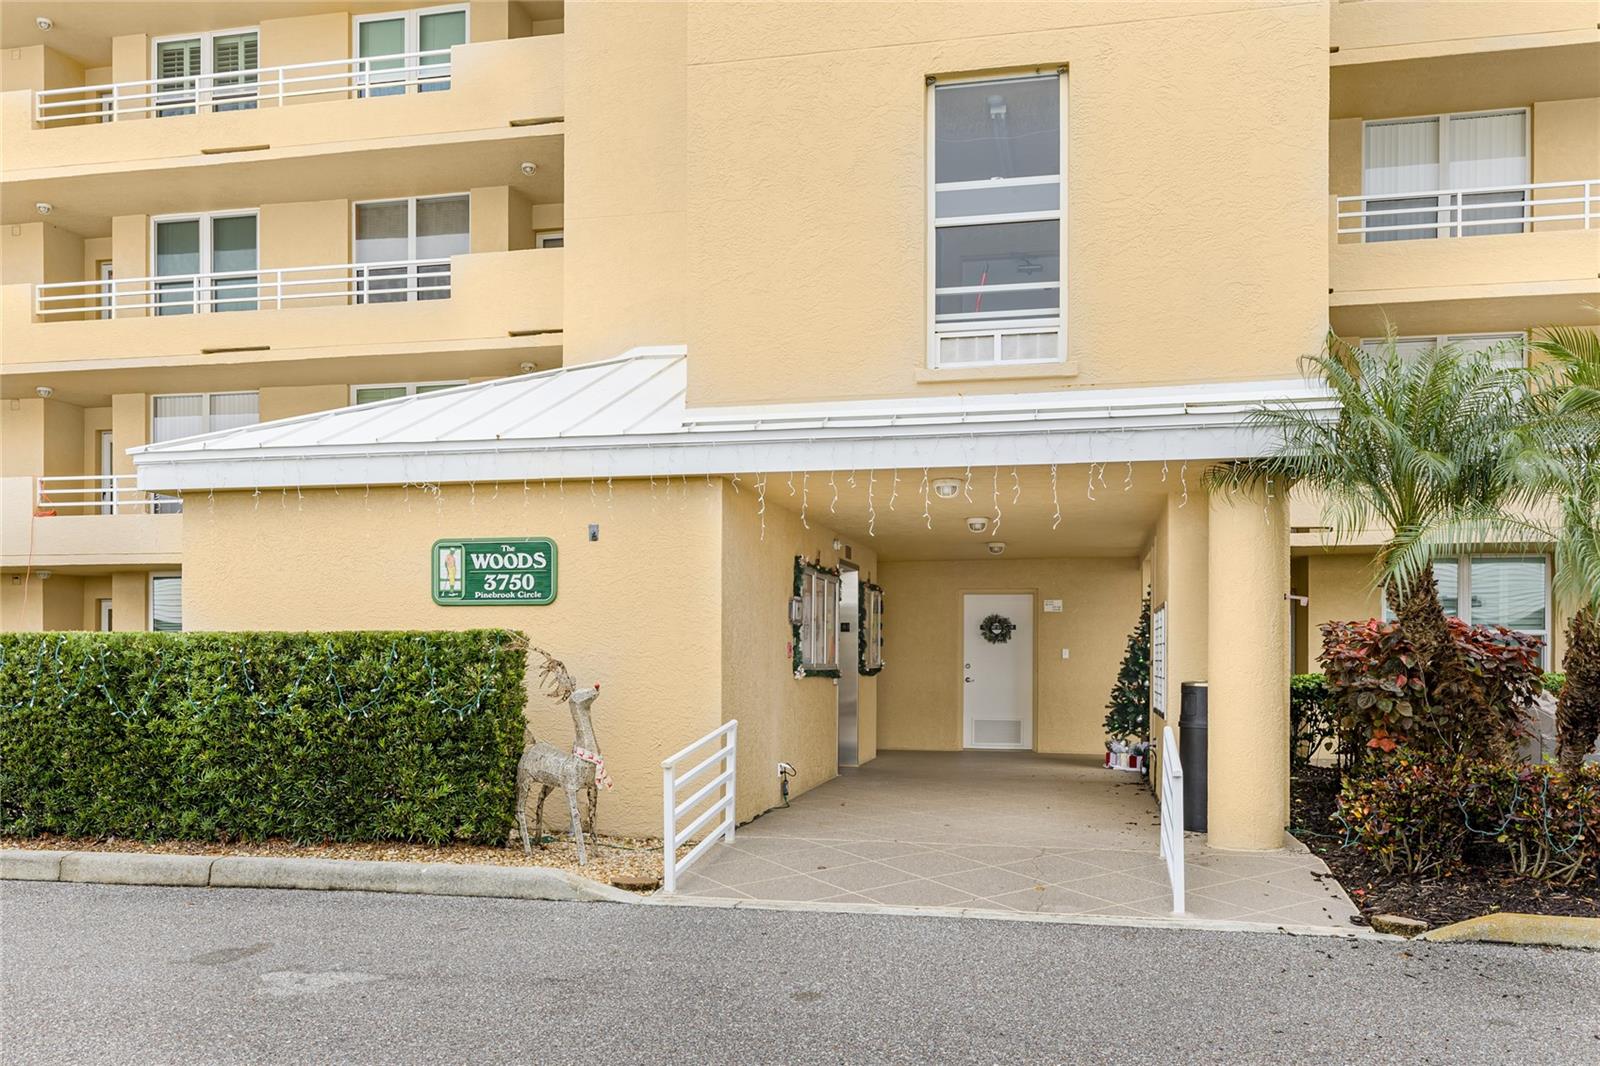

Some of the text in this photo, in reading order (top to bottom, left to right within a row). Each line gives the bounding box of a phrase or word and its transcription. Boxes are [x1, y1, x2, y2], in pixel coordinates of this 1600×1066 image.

[470, 552, 547, 569] WOODS
[484, 574, 535, 590] 3750
[474, 591, 516, 599] Pinebrook
